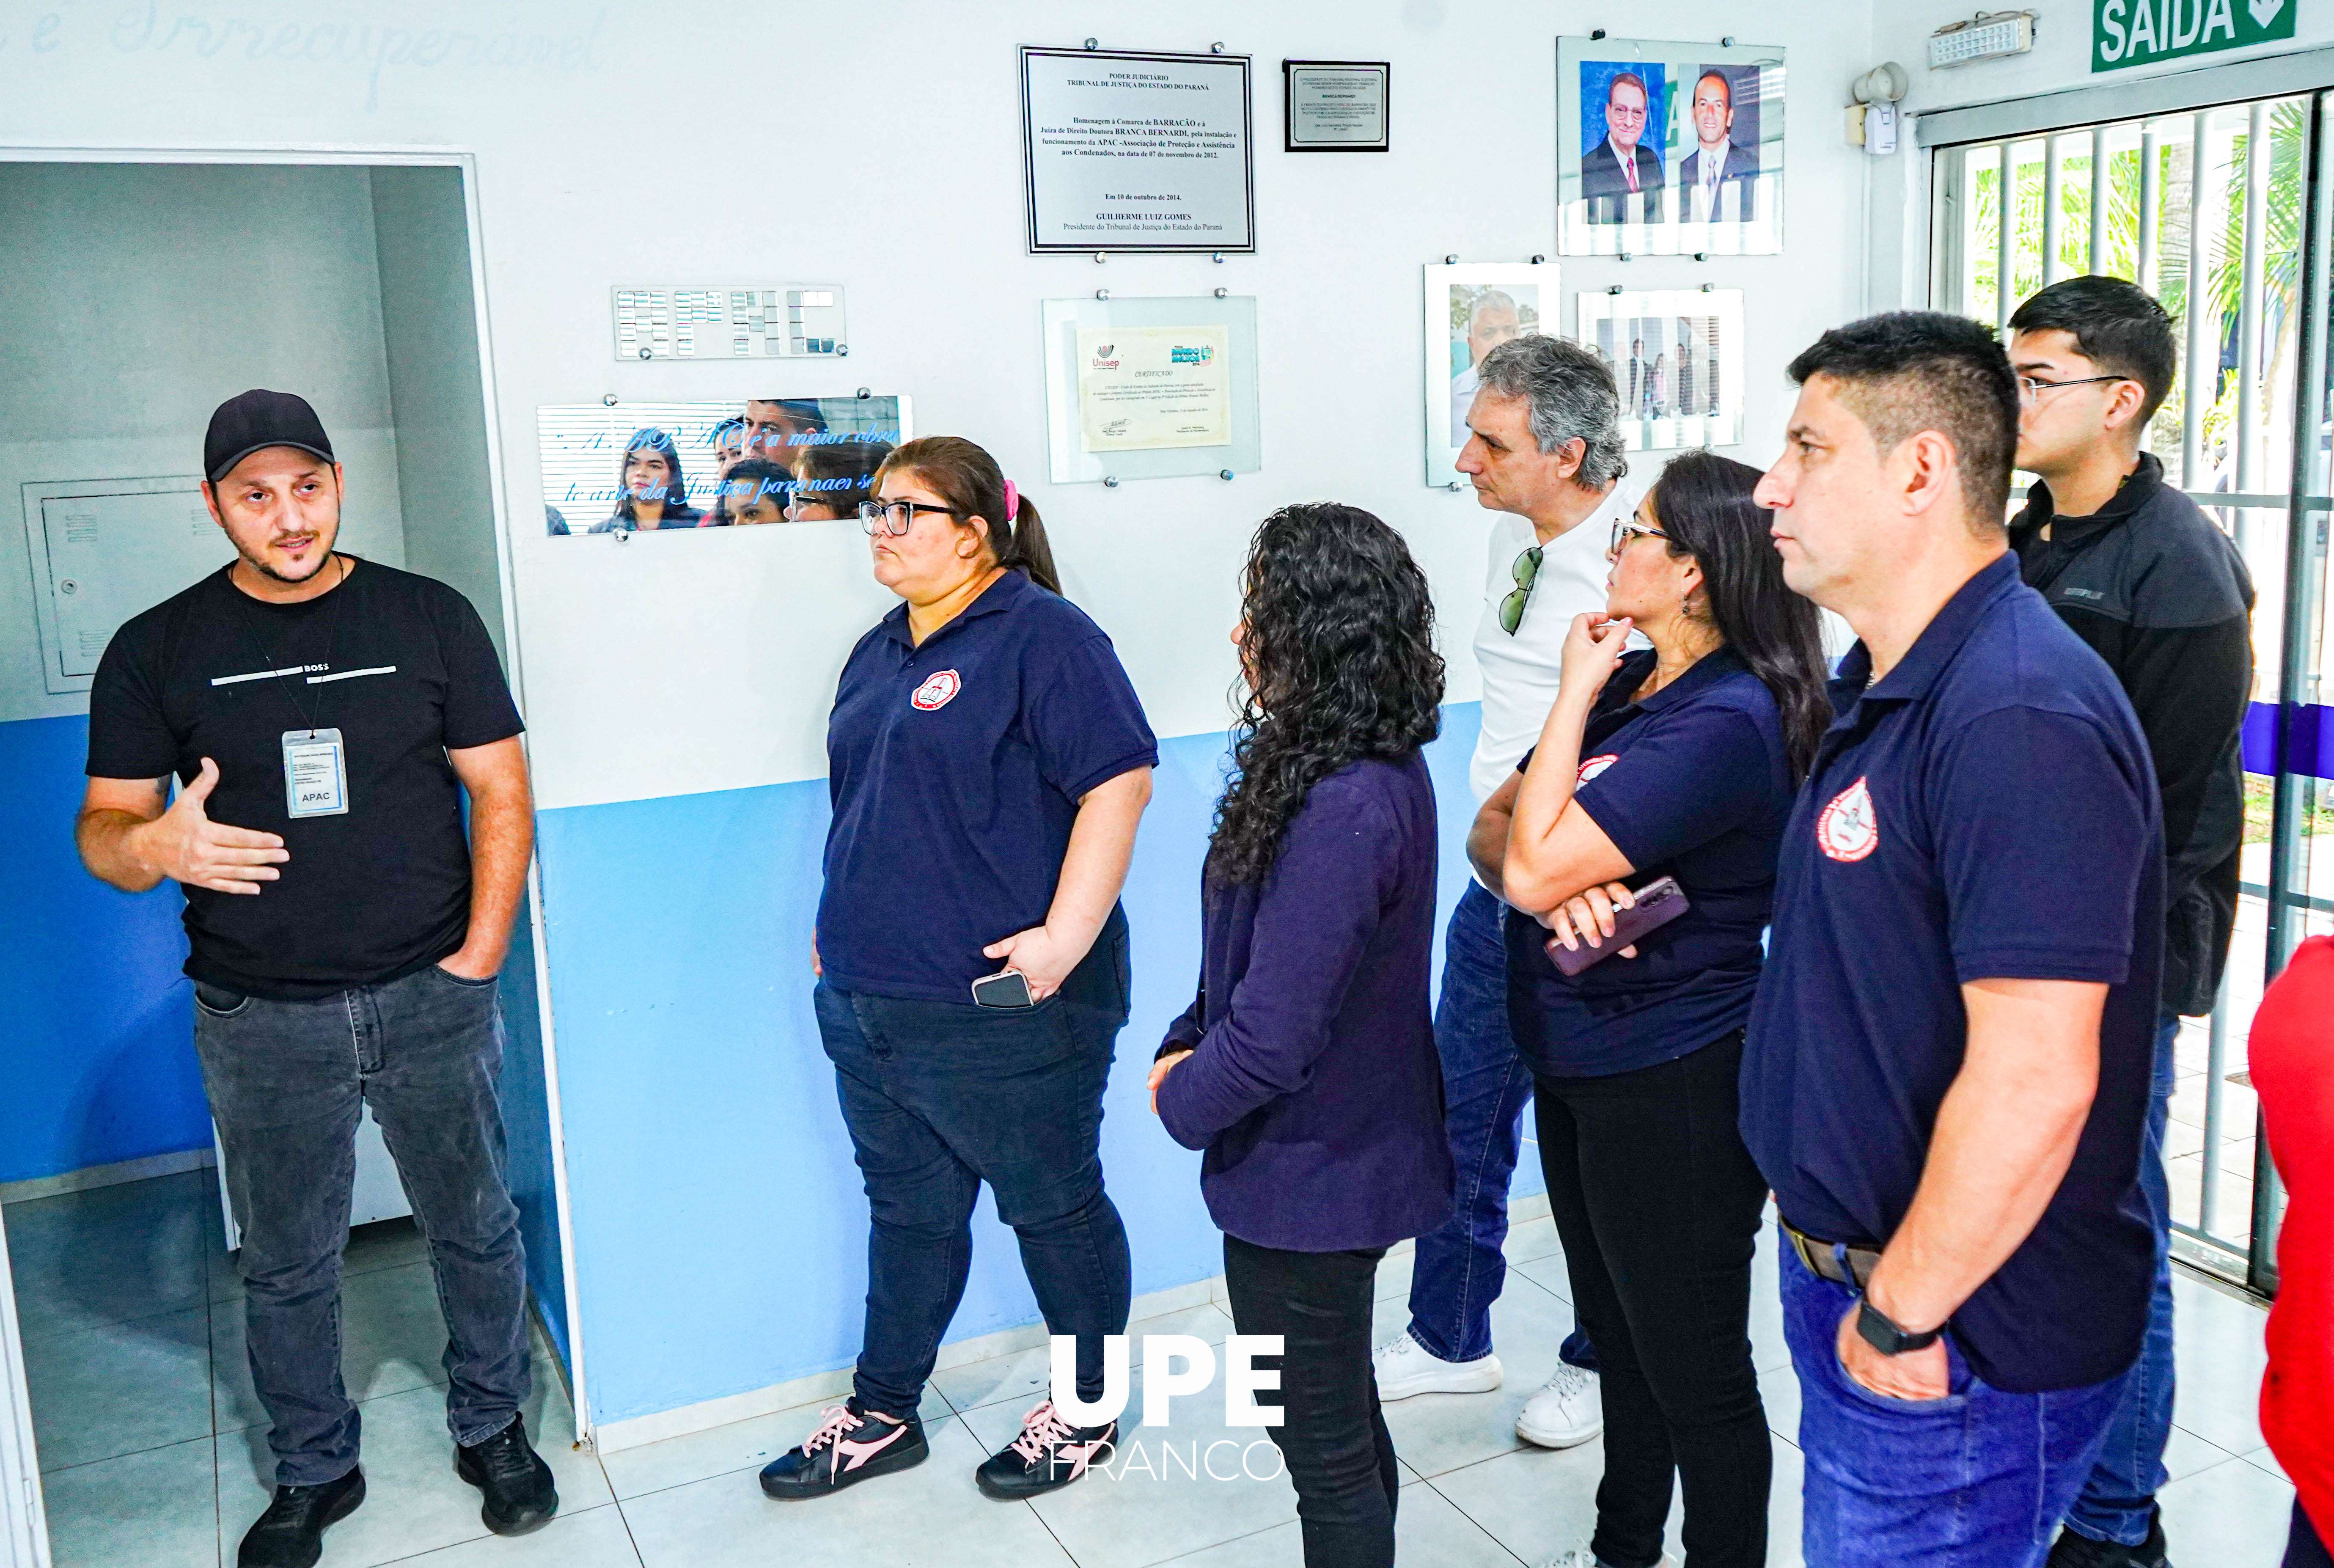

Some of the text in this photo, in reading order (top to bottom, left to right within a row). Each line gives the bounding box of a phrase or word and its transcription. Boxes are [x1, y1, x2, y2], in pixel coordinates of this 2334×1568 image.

[1110, 80, 1137, 88] JUSTIÇA
[1073, 116, 1111, 126] Homenagem
[1153, 118, 1196, 127] BARRACÃO
[1167, 140, 1195, 149] Proteção
[1074, 149, 1116, 157] Condenados,
[1141, 223, 1162, 231] Justiça
[1093, 358, 1119, 371] Unisep
[787, 427, 848, 447] maior
[638, 477, 669, 500] da
[303, 663, 330, 673] BOSS
[302, 792, 330, 802] APAC
